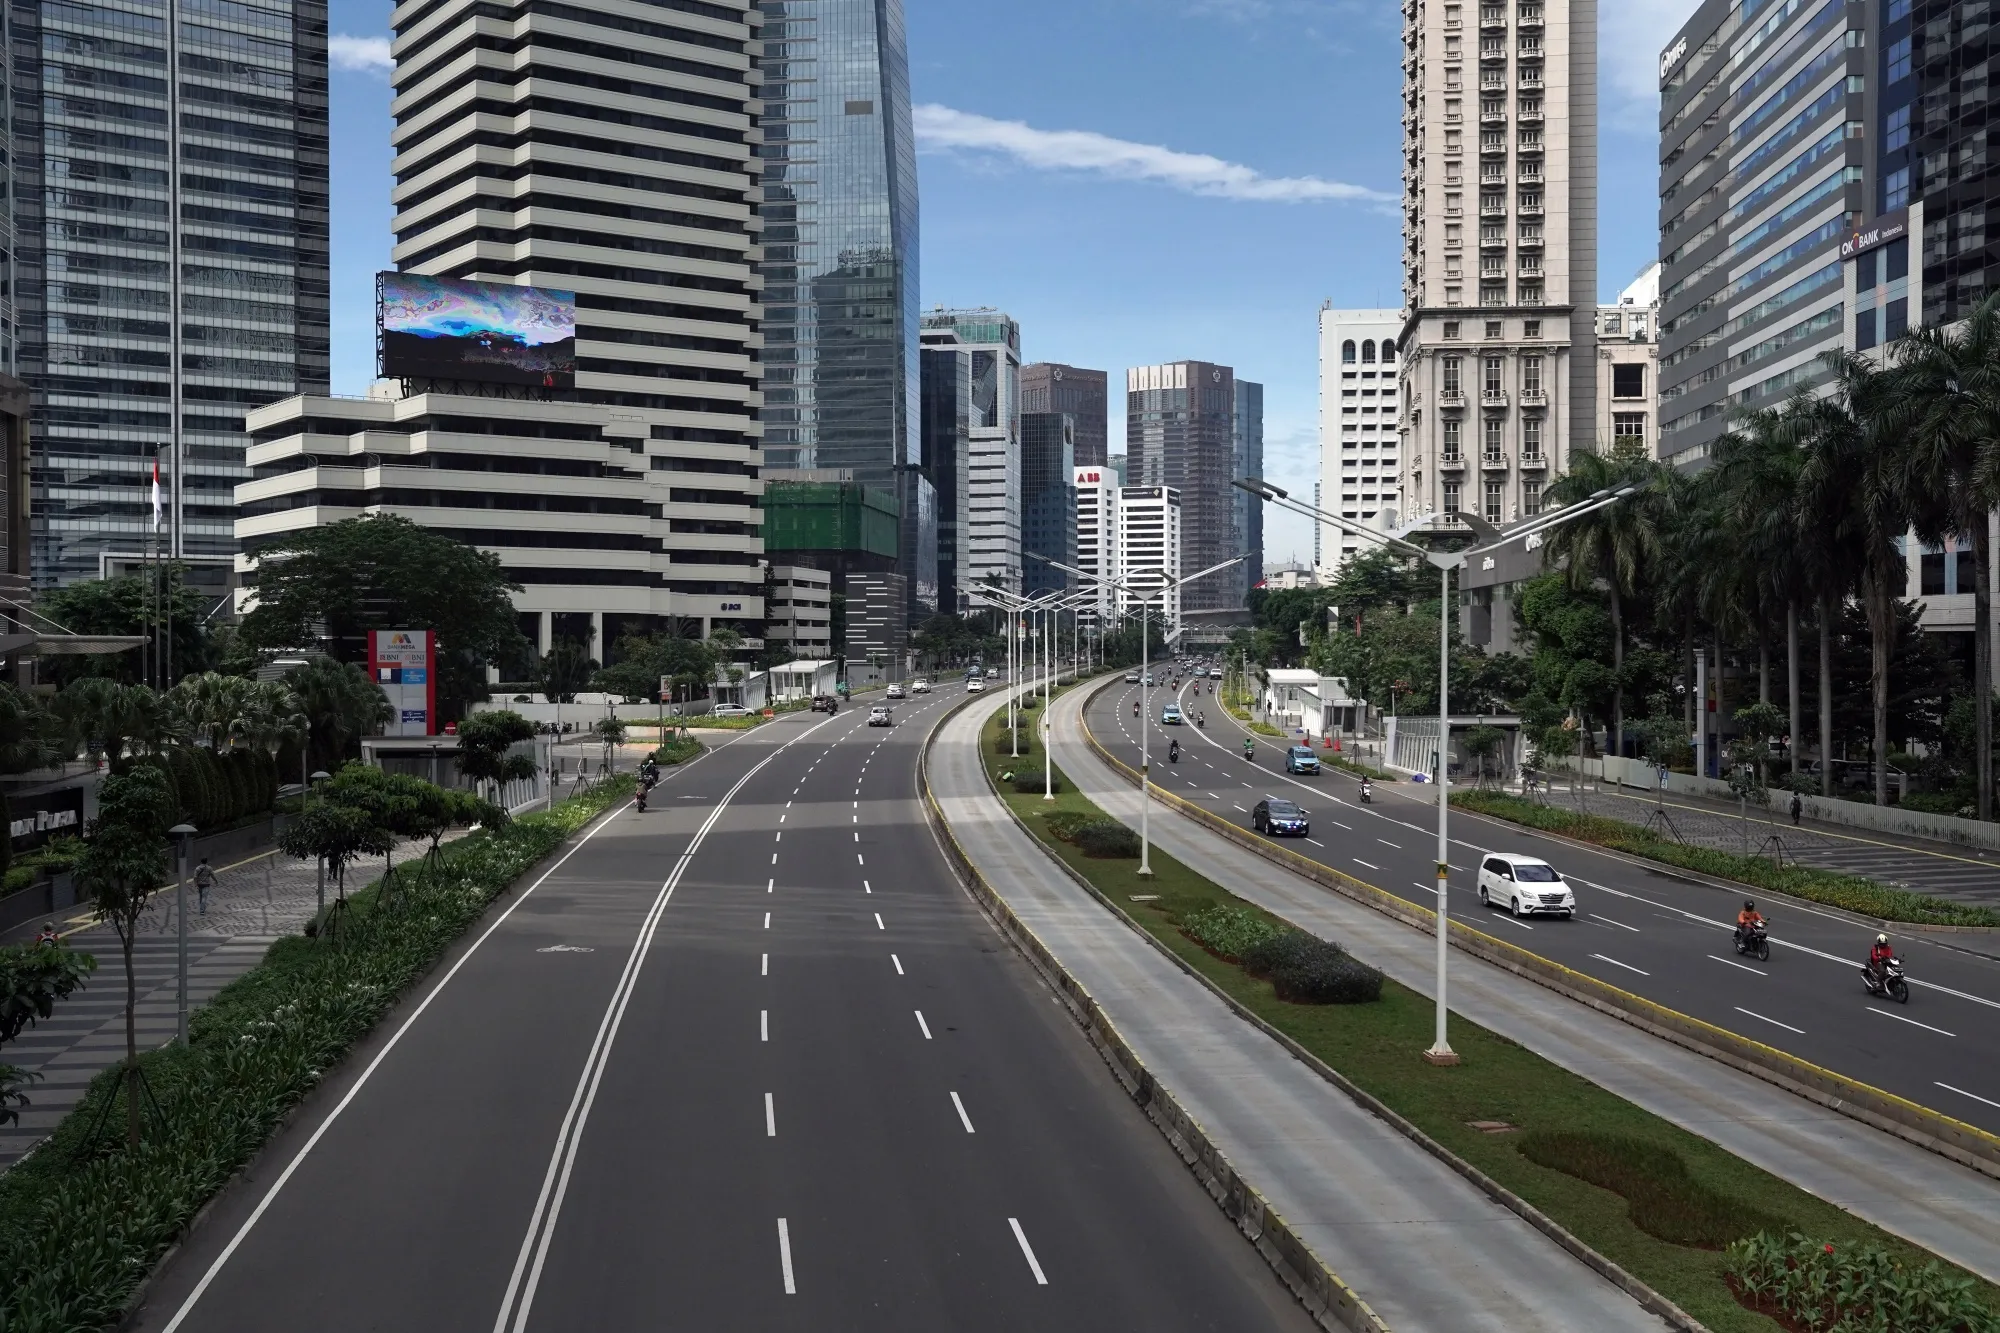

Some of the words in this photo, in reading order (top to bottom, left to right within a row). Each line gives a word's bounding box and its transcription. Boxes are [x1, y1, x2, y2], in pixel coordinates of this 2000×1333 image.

[1841, 240, 1854, 255] OK
[1858, 229, 1879, 248] BANK
[1882, 224, 1903, 238] Indonesia
[1077, 473, 1100, 483] ABB
